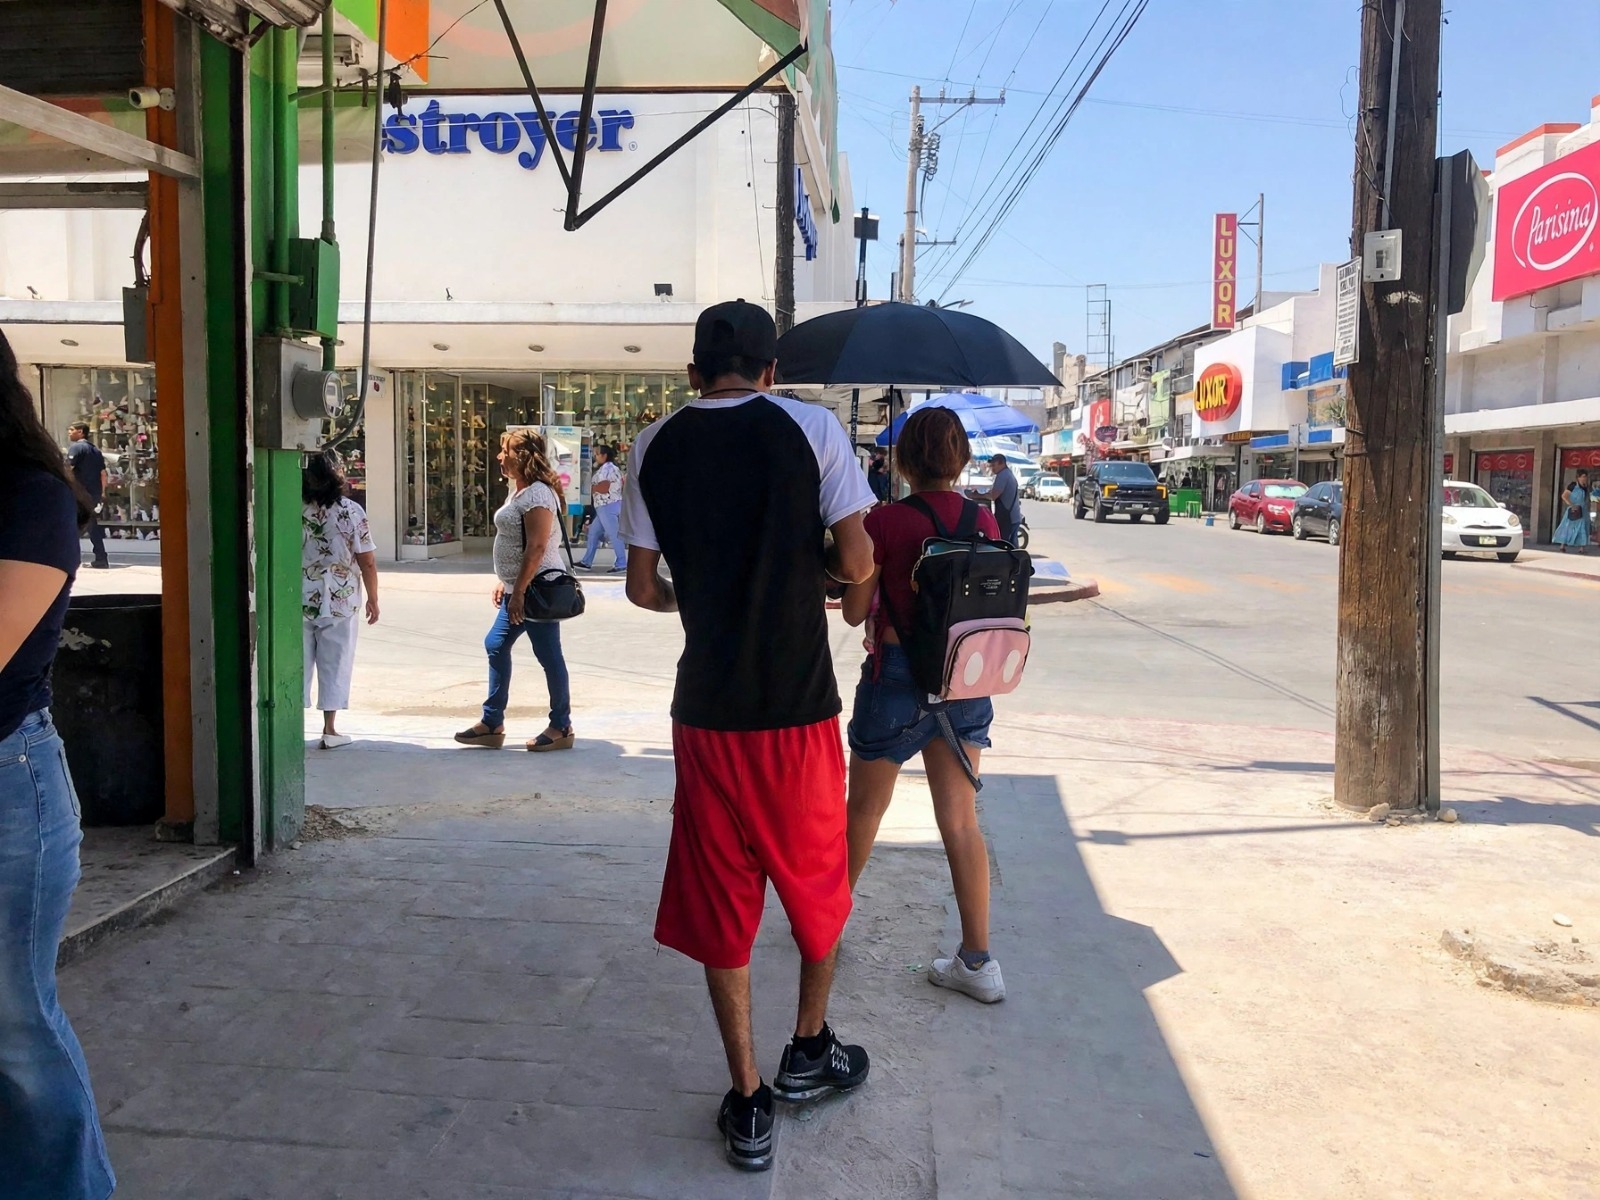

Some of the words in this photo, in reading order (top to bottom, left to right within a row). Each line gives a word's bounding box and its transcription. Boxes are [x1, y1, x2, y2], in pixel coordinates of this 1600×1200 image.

[1528, 198, 1591, 246] Parisina
[1217, 217, 1234, 324] LUXOR
[1195, 373, 1228, 411] LUXOR
